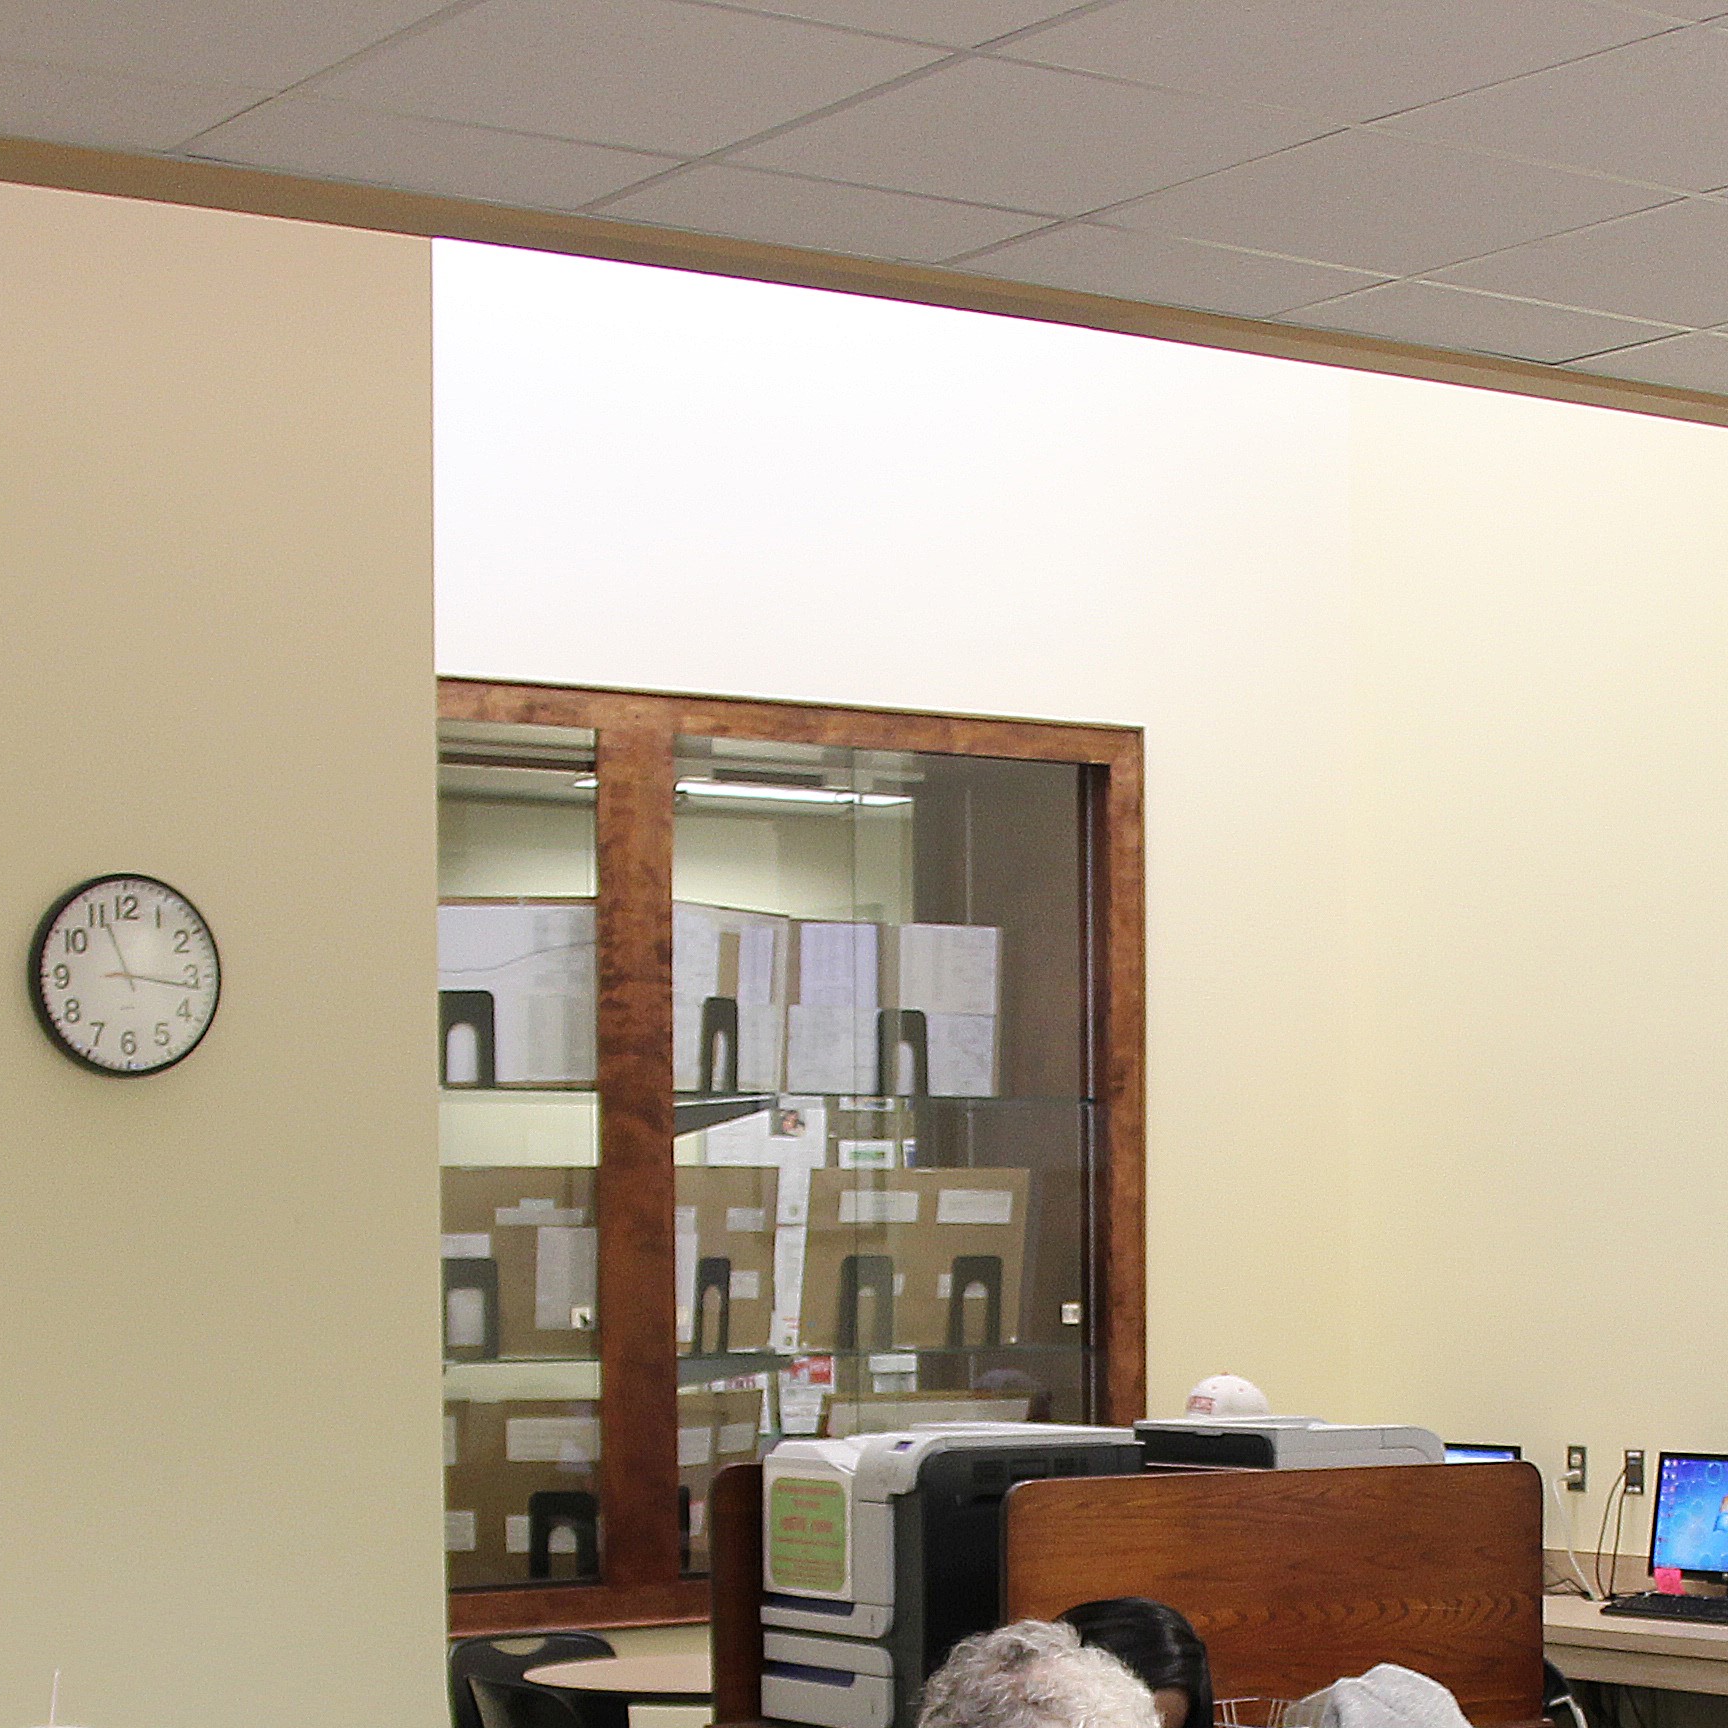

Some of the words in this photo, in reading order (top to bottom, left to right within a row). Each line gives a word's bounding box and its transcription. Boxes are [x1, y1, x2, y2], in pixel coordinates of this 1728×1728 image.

[88, 903, 105, 928] 11
[114, 895, 139, 920] 12
[155, 904, 161, 929] 1
[64, 928, 88, 953] 10
[172, 929, 190, 953] 2
[53, 963, 70, 990] 9
[182, 964, 199, 990] 3
[64, 998, 81, 1023] 8
[176, 998, 192, 1022] 4
[89, 1021, 105, 1046] 7
[121, 1031, 136, 1055] 6
[154, 1022, 170, 1046] 5
